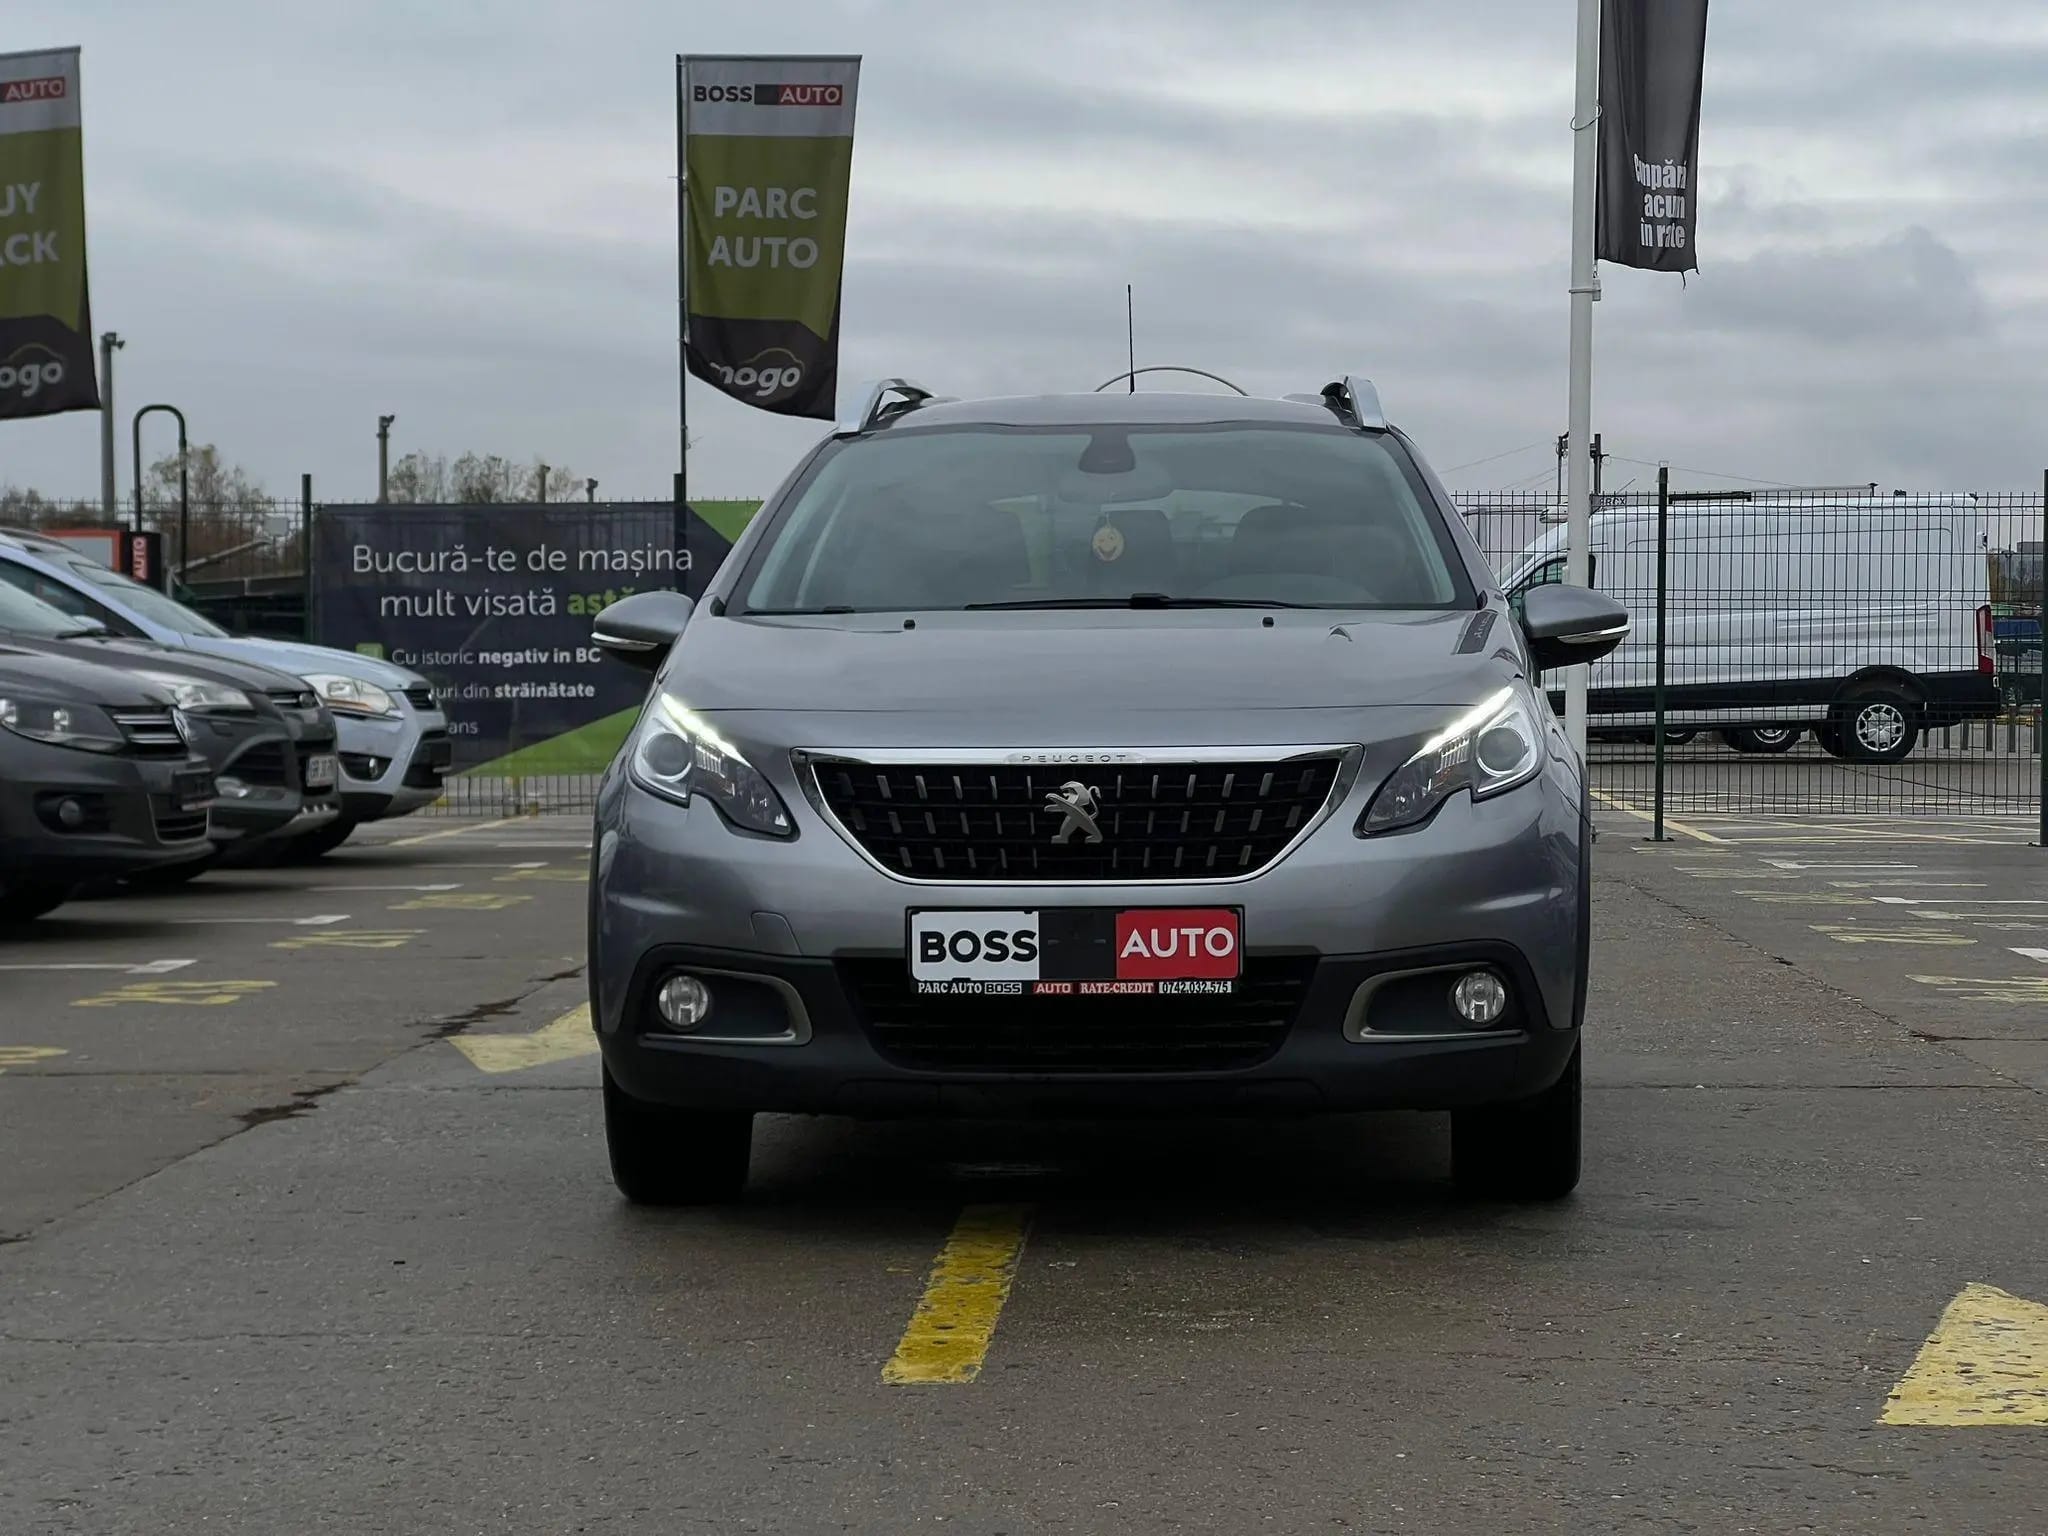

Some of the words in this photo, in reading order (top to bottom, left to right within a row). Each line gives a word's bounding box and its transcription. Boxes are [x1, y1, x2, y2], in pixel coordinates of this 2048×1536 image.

[5, 79, 63, 100] AUTO
[693, 85, 752, 102] BOSS
[780, 86, 840, 103] AUTO
[714, 186, 818, 219] PARC
[0, 231, 60, 266] CK
[1656, 222, 1685, 248] rate
[707, 235, 819, 268] AUTO
[353, 545, 516, 573] Bucură-te
[527, 544, 567, 571] de
[578, 543, 693, 577] mașina
[380, 589, 456, 617] mult
[465, 587, 556, 617] visată
[392, 650, 416, 665] Cu
[422, 648, 474, 665] istoric
[478, 647, 549, 668] negativ
[553, 648, 570, 663] in
[576, 647, 601, 663] BC
[436, 682, 458, 699] uri
[463, 682, 489, 699] din
[494, 681, 595, 698] străinătate
[919, 930, 1038, 963] BOSS
[1120, 927, 1234, 959] AUTO
[917, 983, 948, 994] PARC
[950, 983, 982, 994] AUTO
[985, 983, 1021, 994] BOSS
[1036, 984, 1071, 994] AUTO
